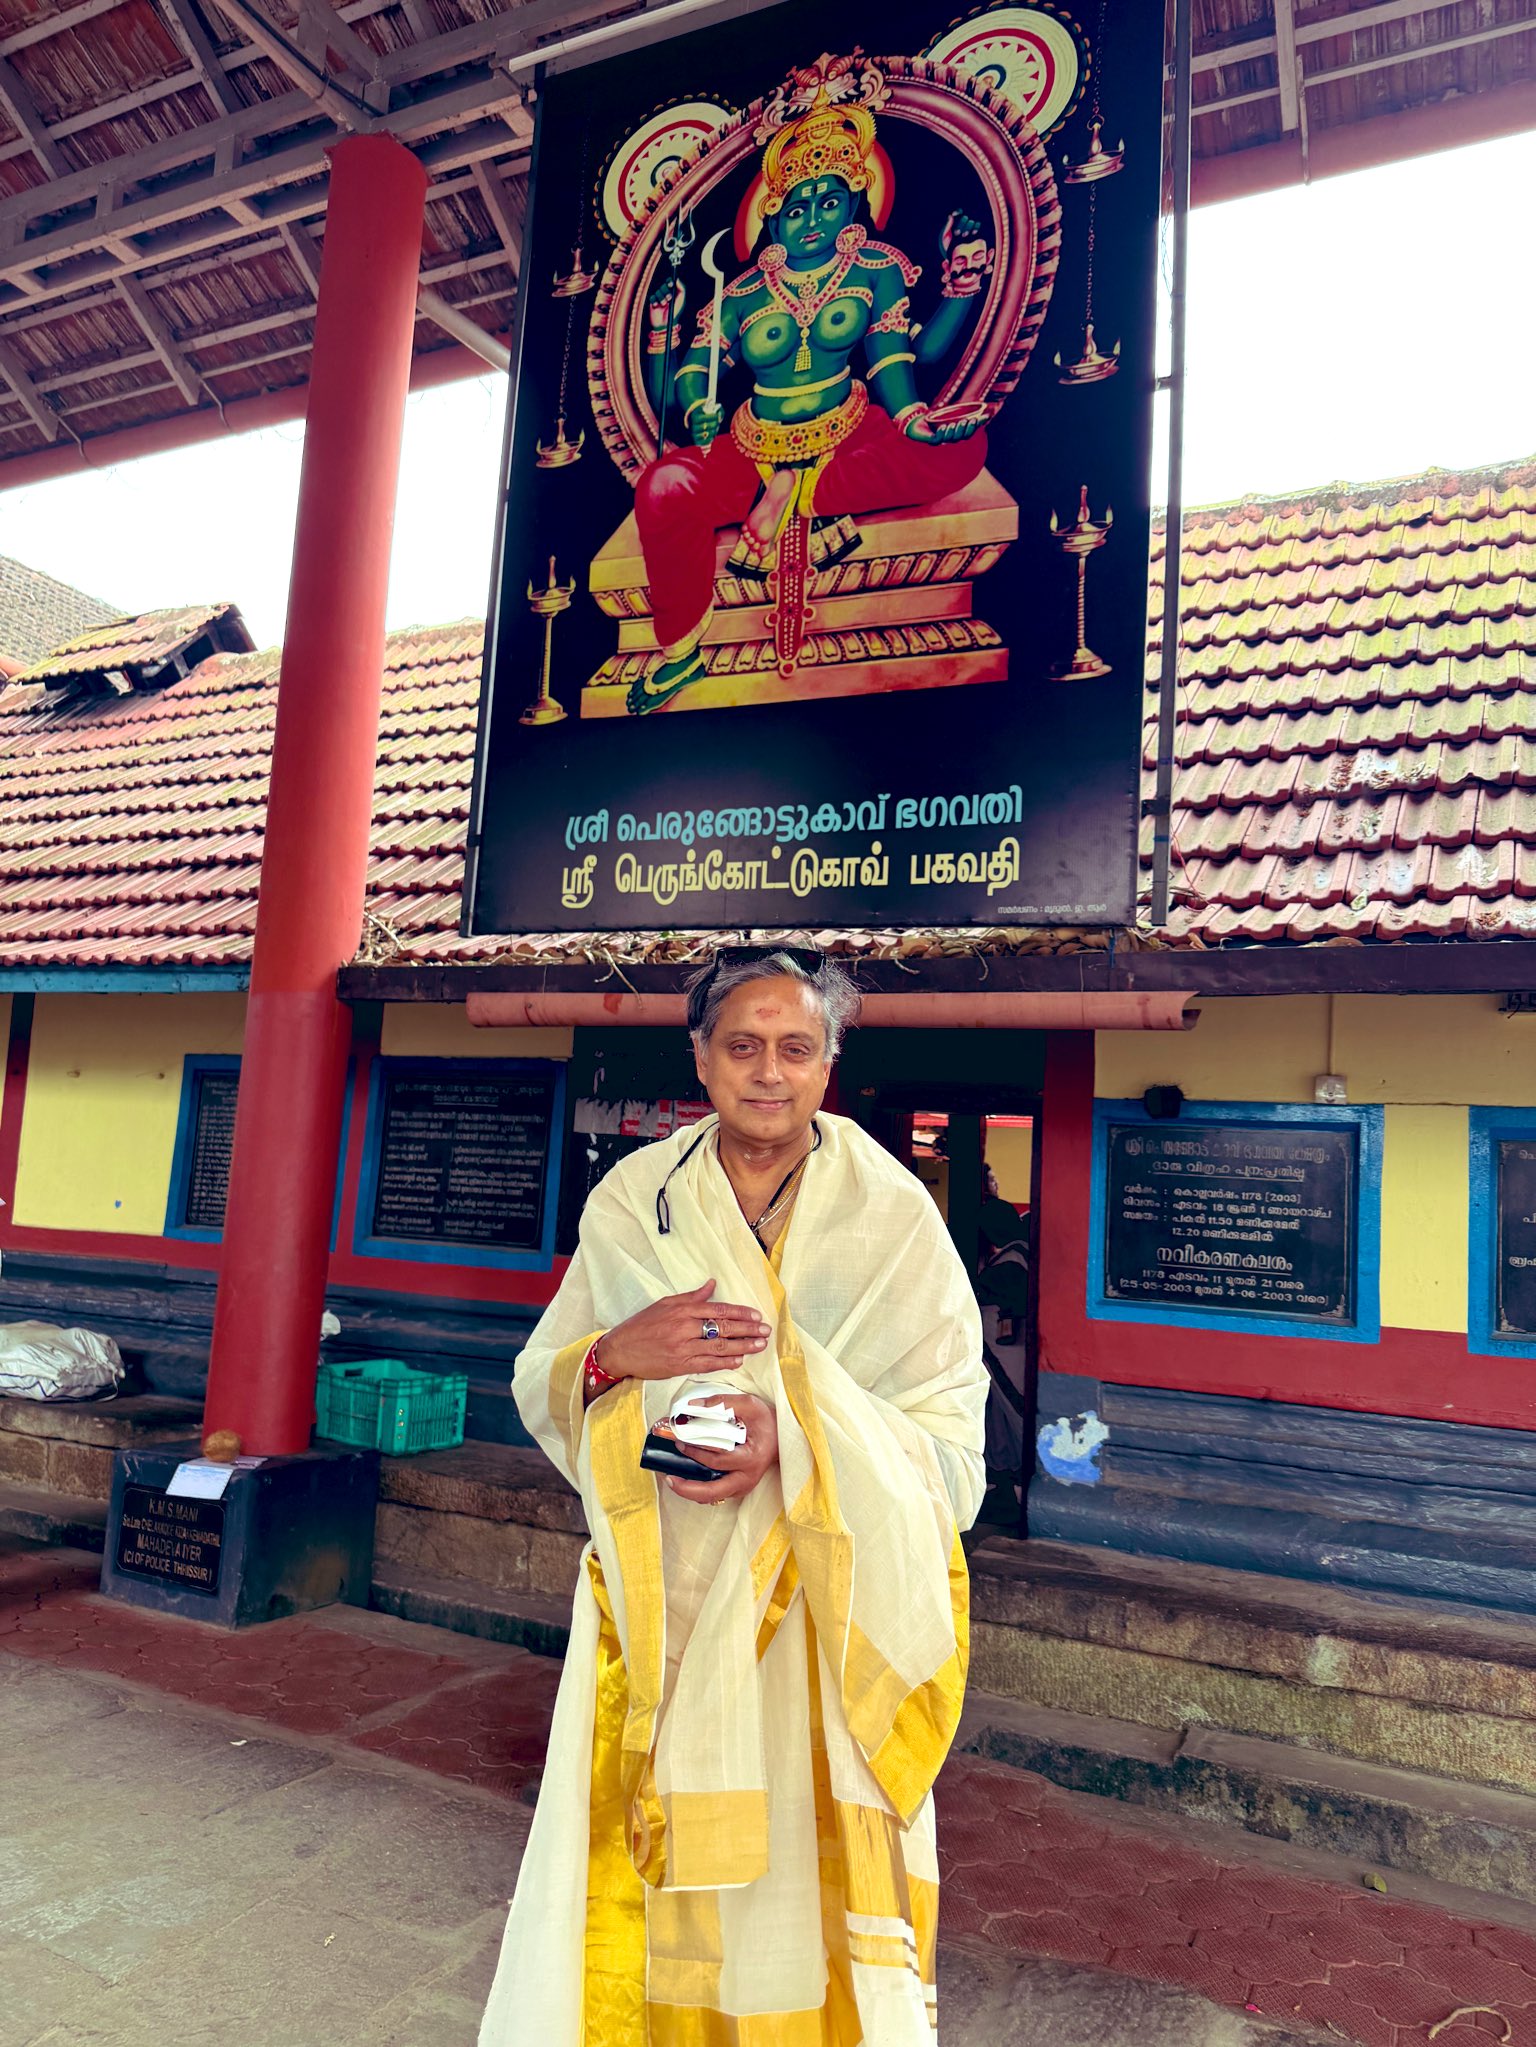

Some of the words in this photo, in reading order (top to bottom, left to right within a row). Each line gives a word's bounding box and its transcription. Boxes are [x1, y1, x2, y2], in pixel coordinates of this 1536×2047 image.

[565, 808, 609, 851] ശ്രീ
[895, 784, 1023, 829] ഭഗവതി
[615, 840, 889, 906] பெருங்கோட்டுகாவ்
[910, 836, 1020, 897] பகவதி
[1241, 1192, 1262, 1201] 1178
[1156, 1244, 1293, 1271] നവീകരണകലശം
